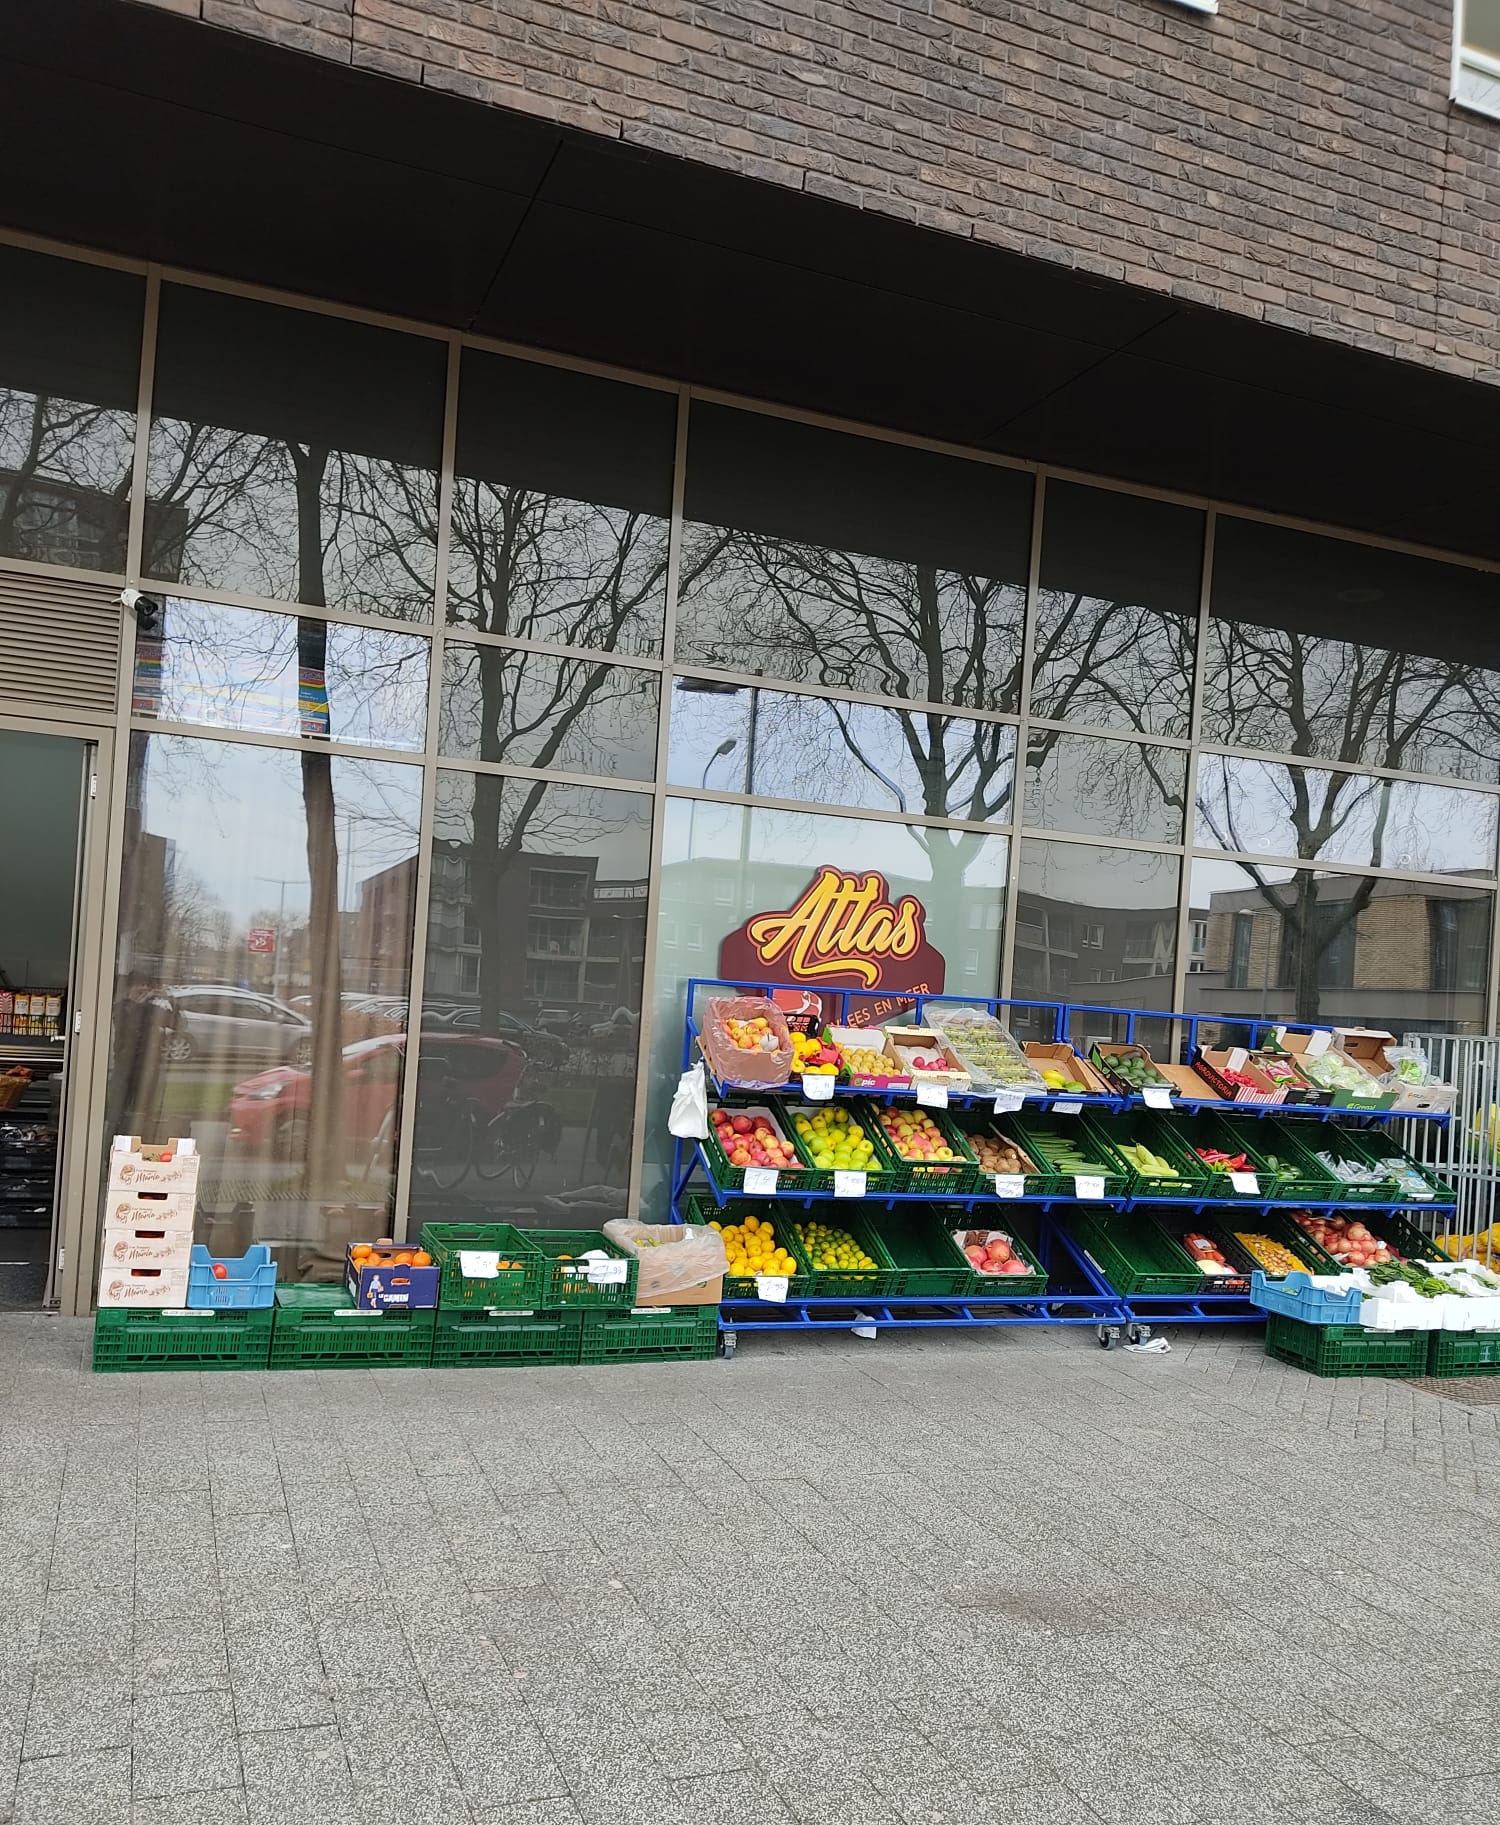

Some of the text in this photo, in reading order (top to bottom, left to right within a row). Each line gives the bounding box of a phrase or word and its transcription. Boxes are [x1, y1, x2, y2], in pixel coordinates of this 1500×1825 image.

[749, 869, 918, 987] Atlas
[830, 1007, 871, 1028] EES
[873, 998, 893, 1016] EN
[853, 1077, 876, 1087] epic
